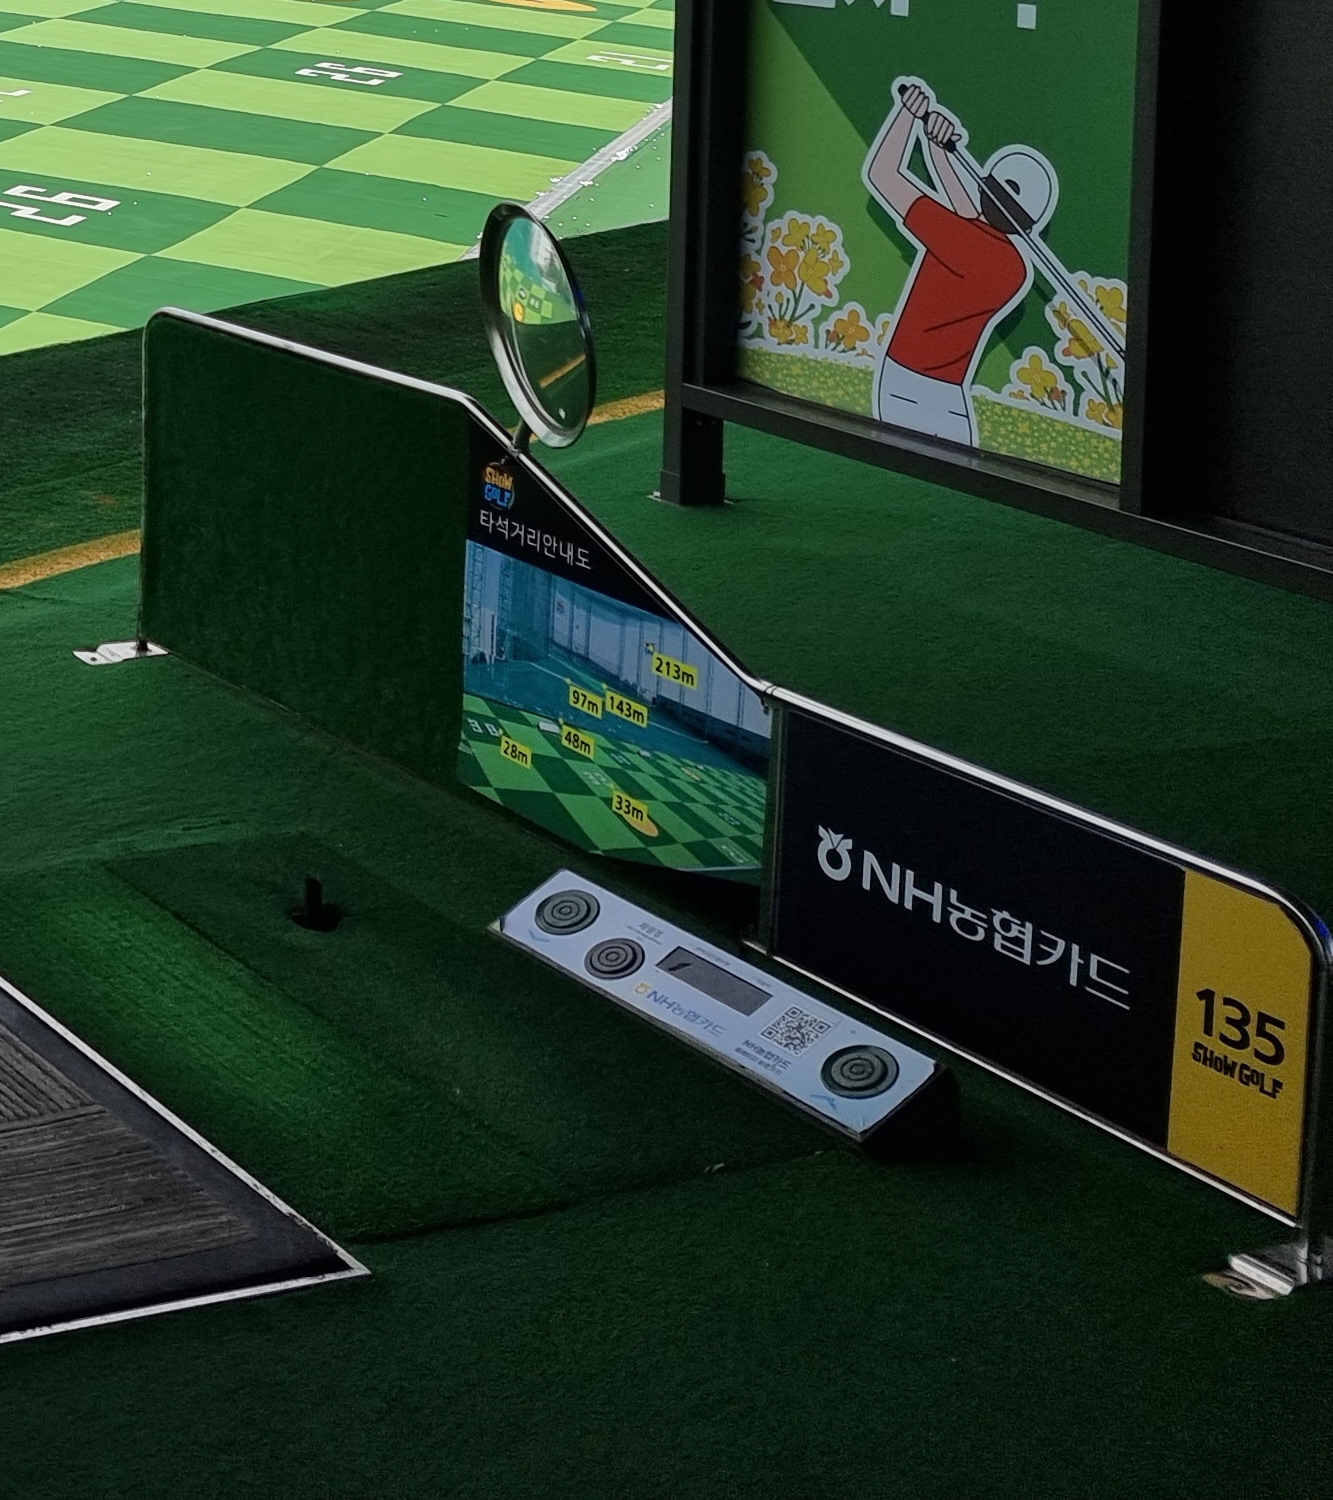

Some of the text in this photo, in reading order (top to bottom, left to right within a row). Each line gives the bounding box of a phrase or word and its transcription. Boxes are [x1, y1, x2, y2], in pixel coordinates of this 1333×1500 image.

[484, 466, 514, 490] SHOW
[484, 484, 512, 508] GOLF
[479, 509, 592, 571] 타석거리안내도
[654, 656, 695, 686] 213m
[571, 688, 600, 713] 97m
[608, 696, 645, 725] 143m
[503, 740, 529, 765] 28m
[563, 729, 592, 755] 48m
[614, 793, 645, 822] 33m
[862, 849, 1131, 1011] NH농협카드
[646, 989, 728, 1038] NH농협카드
[1195, 988, 1286, 1066] 135
[1191, 1041, 1284, 1100] SHOW GOLF
